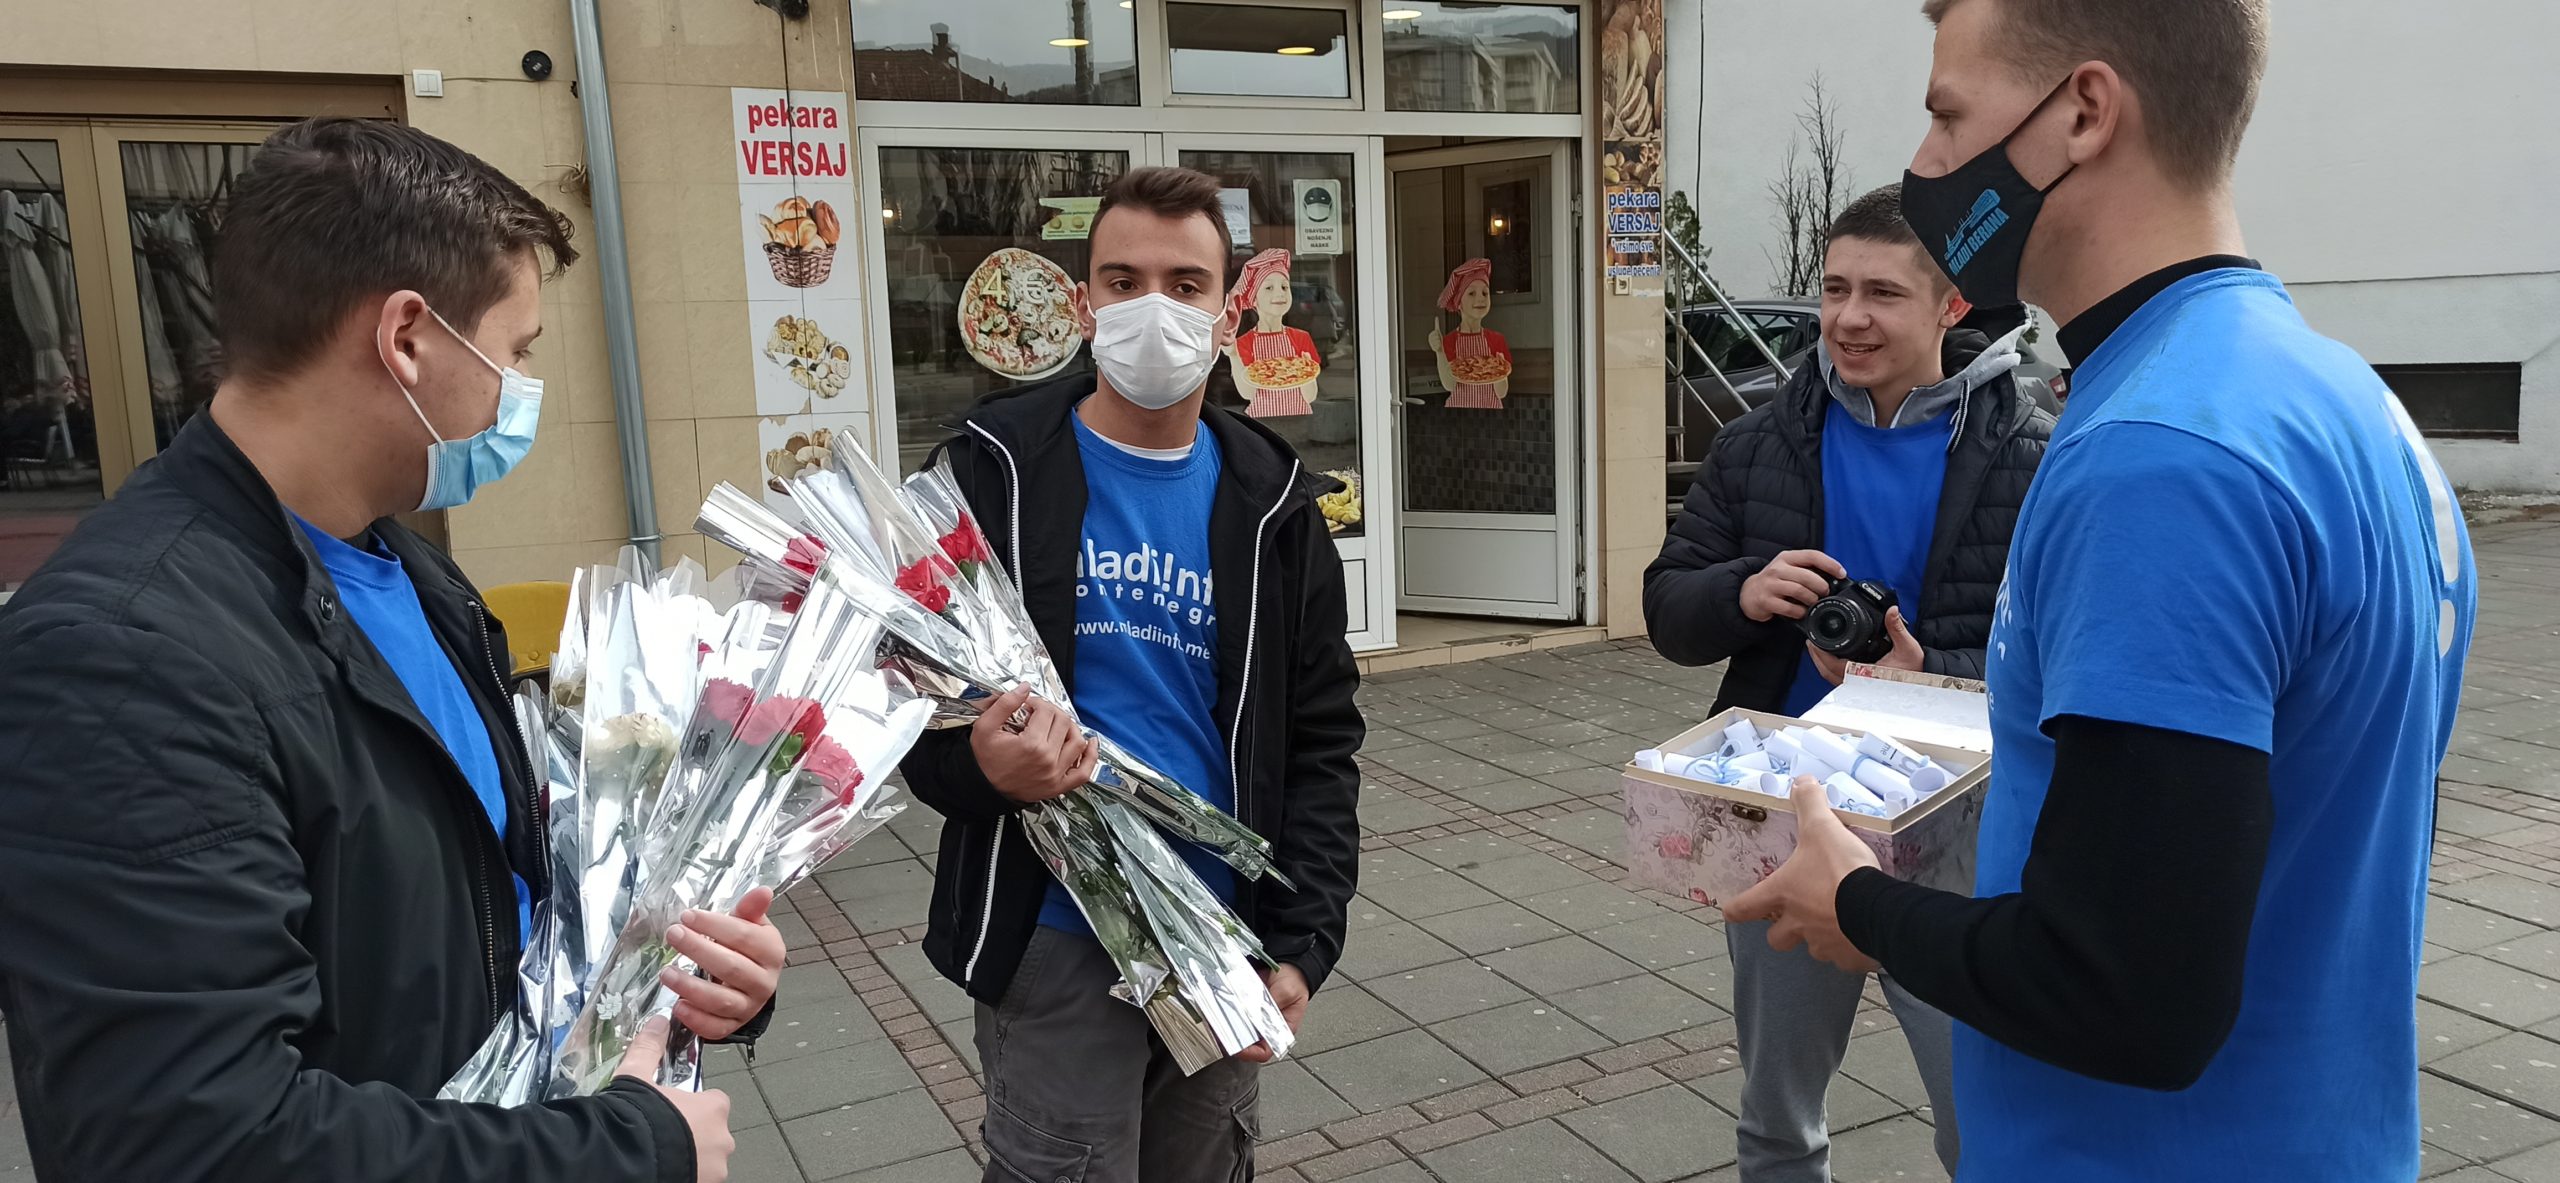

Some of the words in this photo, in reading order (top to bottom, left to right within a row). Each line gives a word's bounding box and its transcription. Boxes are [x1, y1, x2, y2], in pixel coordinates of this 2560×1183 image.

[747, 98, 838, 133] pekara
[740, 139, 847, 177] VERSAJ
[1608, 189, 1659, 210] pekara
[1608, 213, 1661, 232] VERSAJ
[1640, 241, 1654, 252] sve
[1948, 242, 1973, 276] MLADI
[1967, 207, 2009, 252] BERANA
